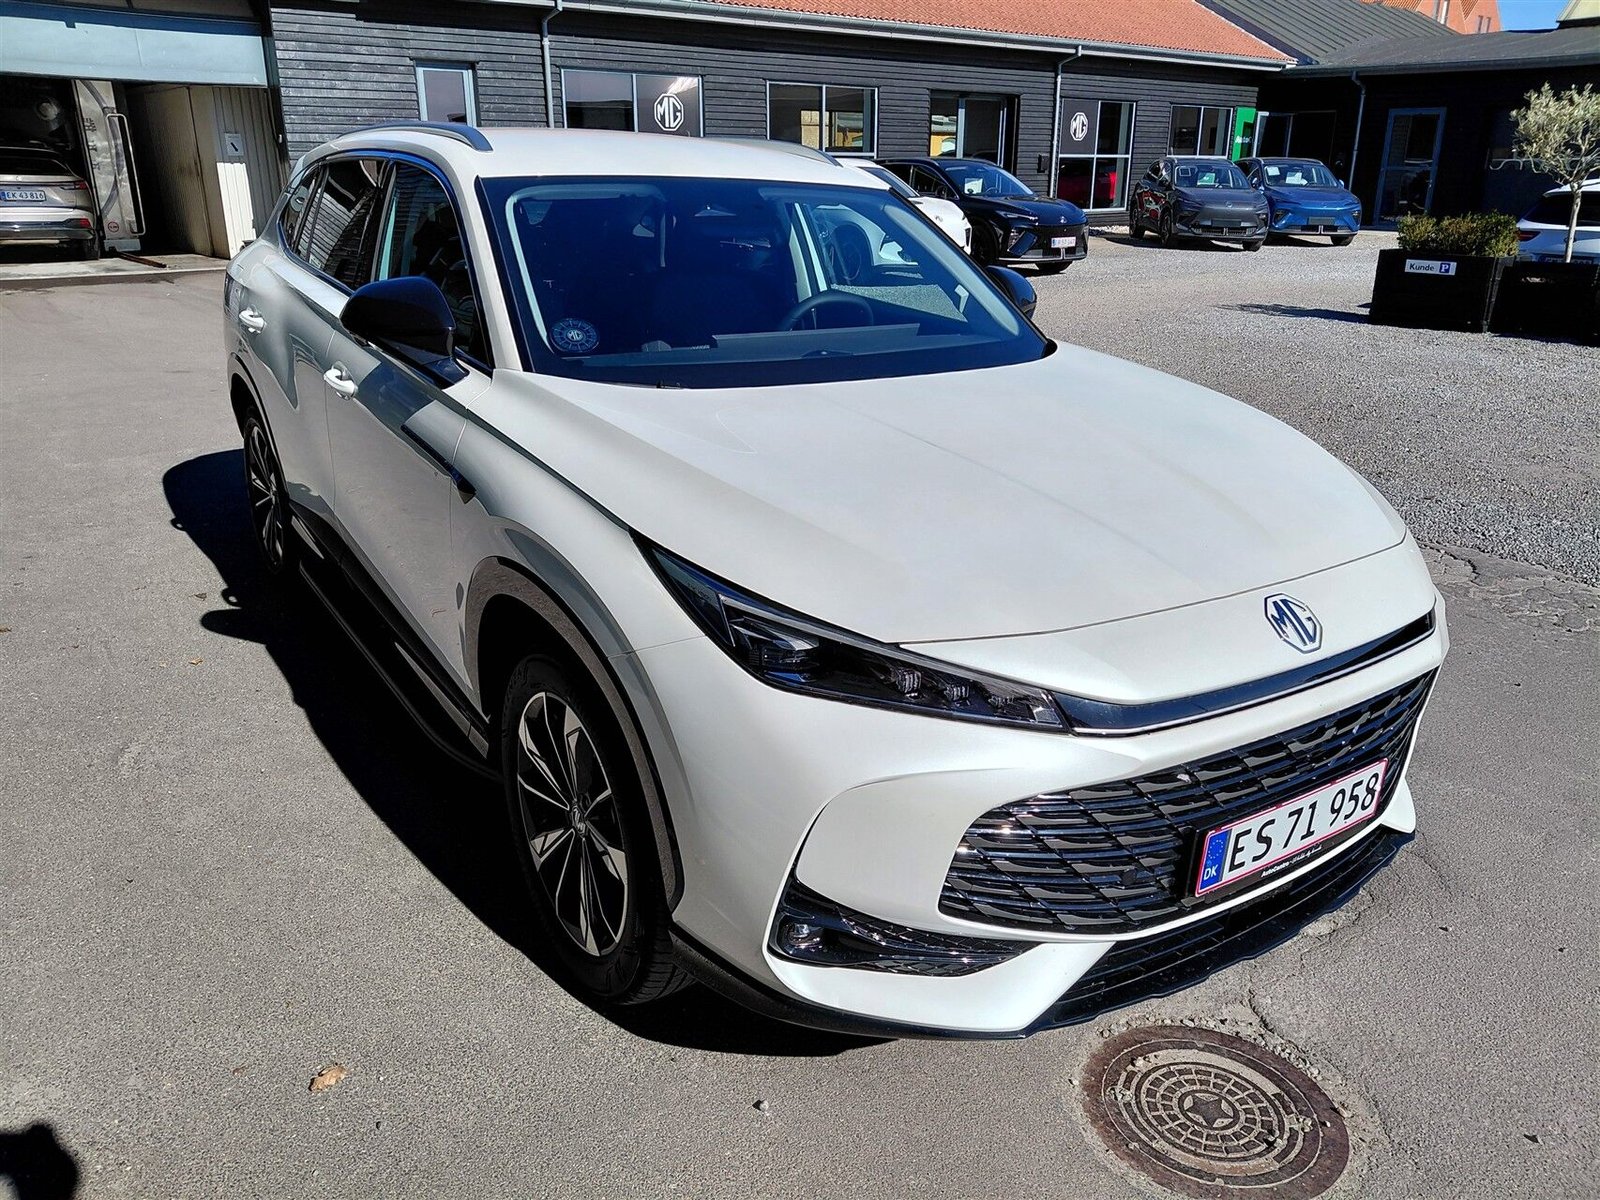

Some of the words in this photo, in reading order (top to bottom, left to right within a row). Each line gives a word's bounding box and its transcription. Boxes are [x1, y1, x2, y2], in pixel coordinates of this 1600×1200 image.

[657, 96, 681, 128] MG
[1072, 114, 1087, 139] MG
[1409, 262, 1435, 271] Kunde
[567, 330, 583, 341] MG
[1270, 598, 1317, 647] MG
[1228, 818, 1275, 873] ES
[1282, 800, 1317, 850] 71
[1329, 772, 1380, 828] 958
[1203, 864, 1217, 881] DK
